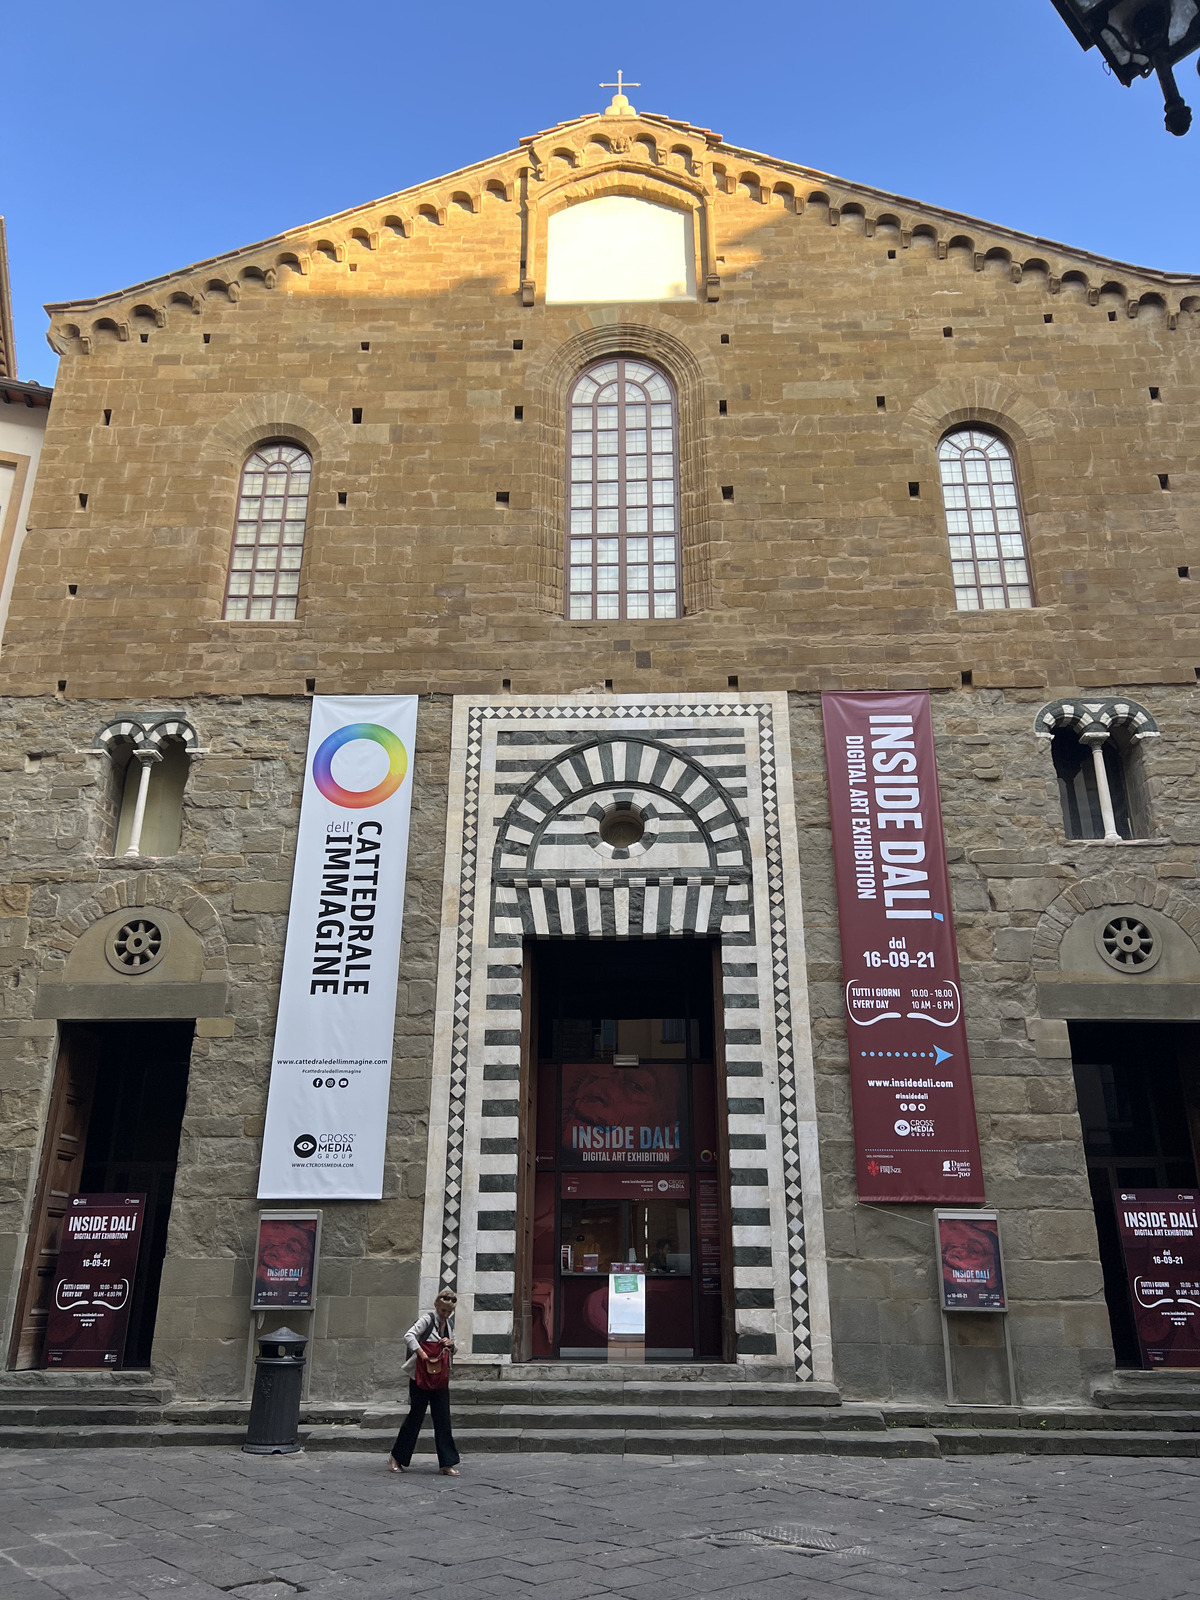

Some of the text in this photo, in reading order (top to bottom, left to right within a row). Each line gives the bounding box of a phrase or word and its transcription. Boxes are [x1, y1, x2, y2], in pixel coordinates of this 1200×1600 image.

[845, 736, 876, 899] DIGITAL ART EXHIBITION
[868, 715, 944, 922] INSIDE DALÍ
[310, 834, 352, 995] IMMAGINE
[342, 821, 382, 995] CATTEDRALE
[889, 937, 906, 949] dal
[862, 951, 935, 968] 16-09-21
[852, 988, 870, 996] TUTTI
[876, 988, 900, 997] GIORNI
[910, 989, 928, 997] 10.00
[935, 989, 952, 998] 18.00
[853, 1000, 874, 1009] EVERY
[876, 1000, 889, 1009] DAY
[944, 1001, 954, 1009] PM
[868, 1078, 953, 1088] www.insidedali.com
[572, 1121, 680, 1149] INSIDE DALÍ
[318, 1144, 352, 1152] MEDIA
[583, 1152, 670, 1162] DIGITAL ART EXHIBITION
[68, 1213, 138, 1231] INSIDE DALÍ
[1124, 1212, 1167, 1228] INSIDE
[953, 1269, 974, 1278] INSIDE
